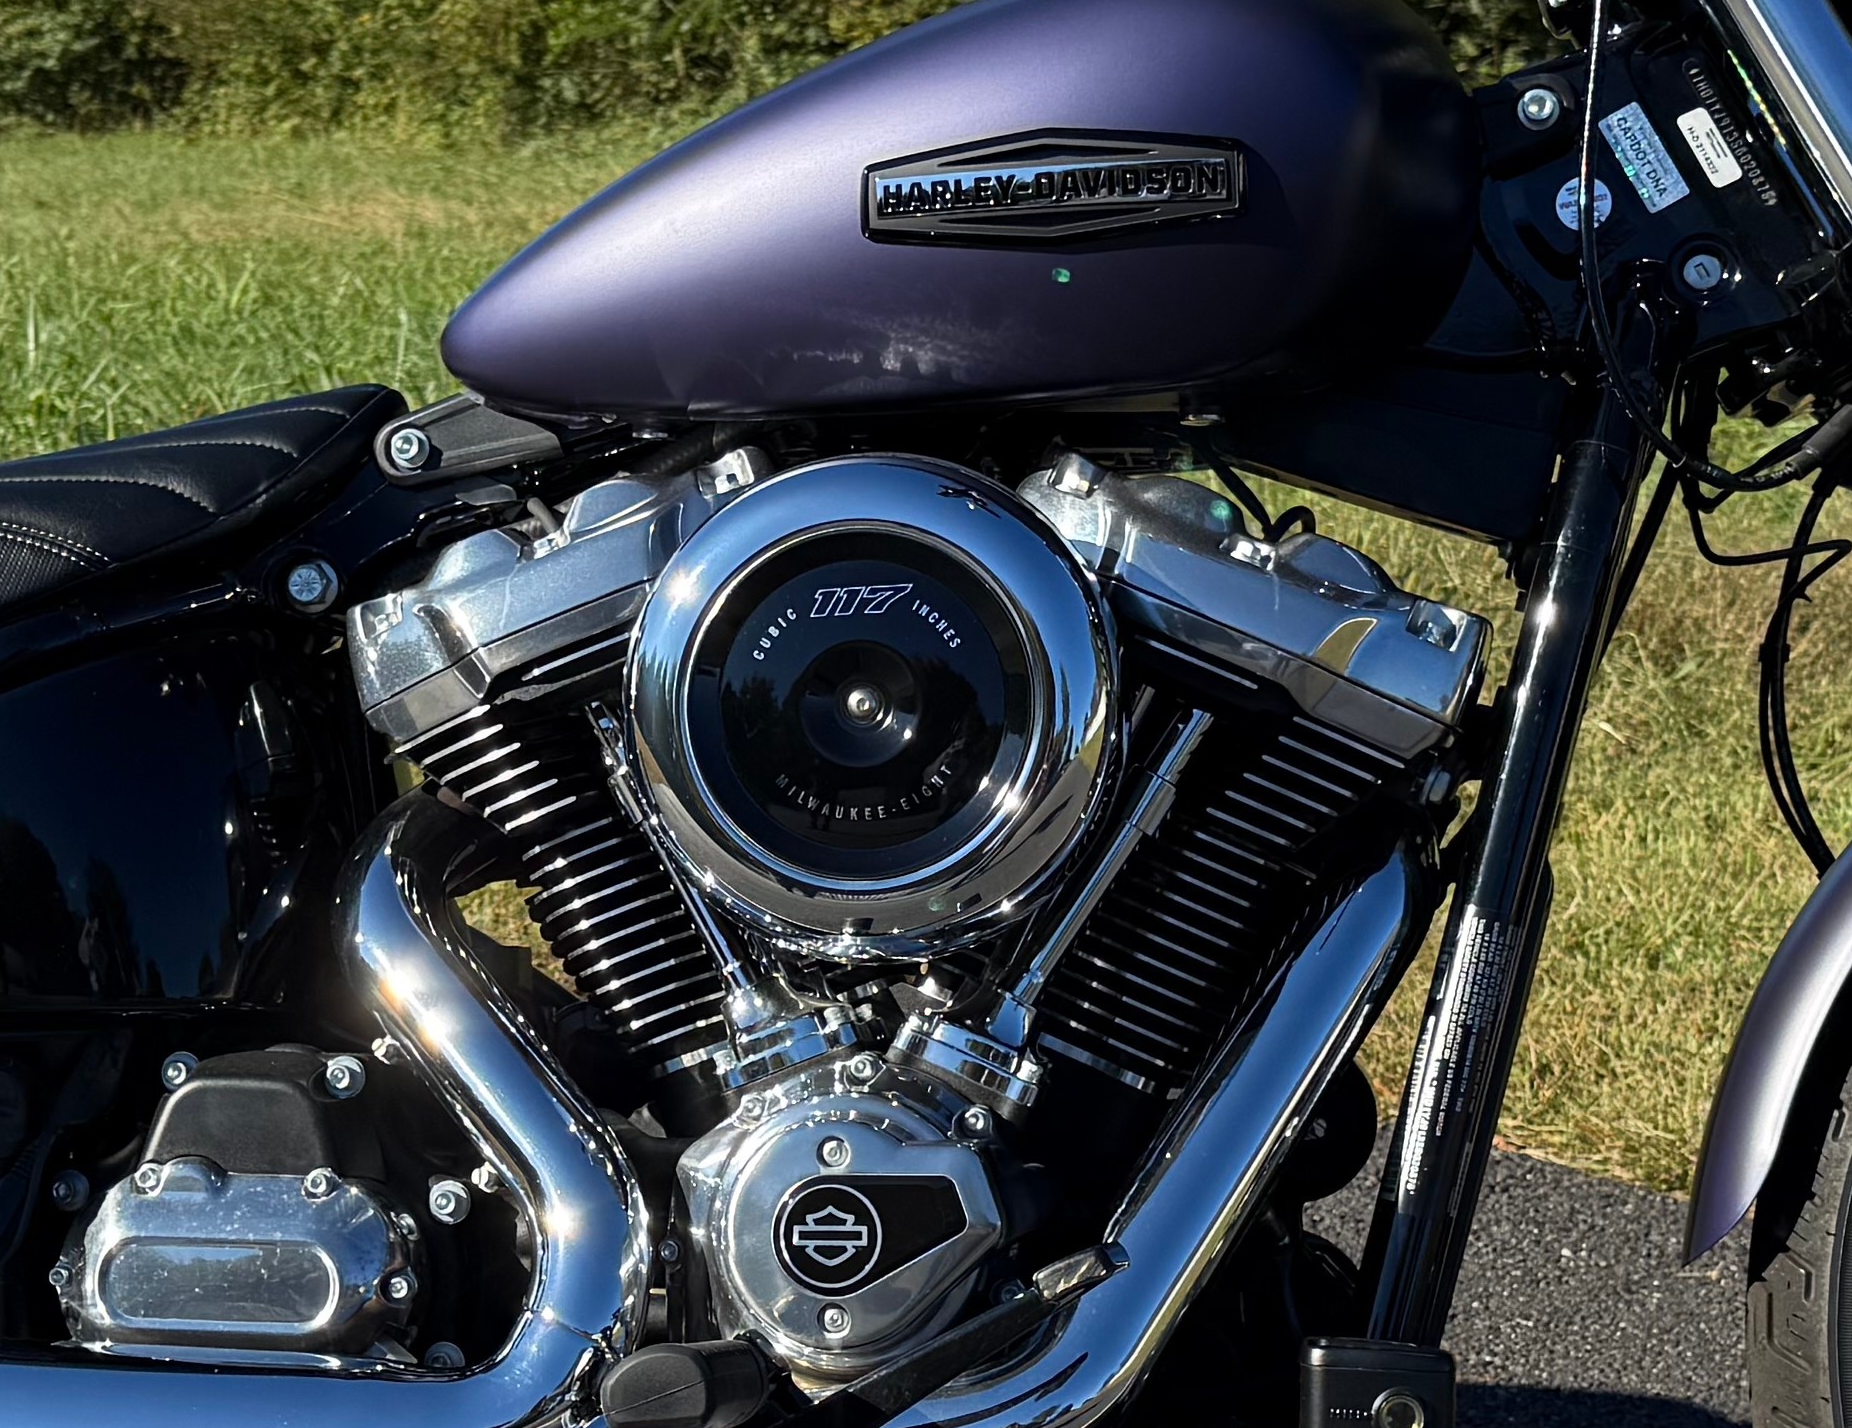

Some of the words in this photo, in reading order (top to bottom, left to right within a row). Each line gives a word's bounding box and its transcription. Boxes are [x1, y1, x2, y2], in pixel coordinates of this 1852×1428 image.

[881, 162, 1223, 213] HARLEY-DAVIDSON
[1646, 168, 1668, 198] DNA
[752, 608, 798, 662] CUBIC
[810, 583, 913, 618] 117
[912, 599, 961, 651] INCHES
[774, 762, 953, 823] MILWAUKEE-EIGHT
